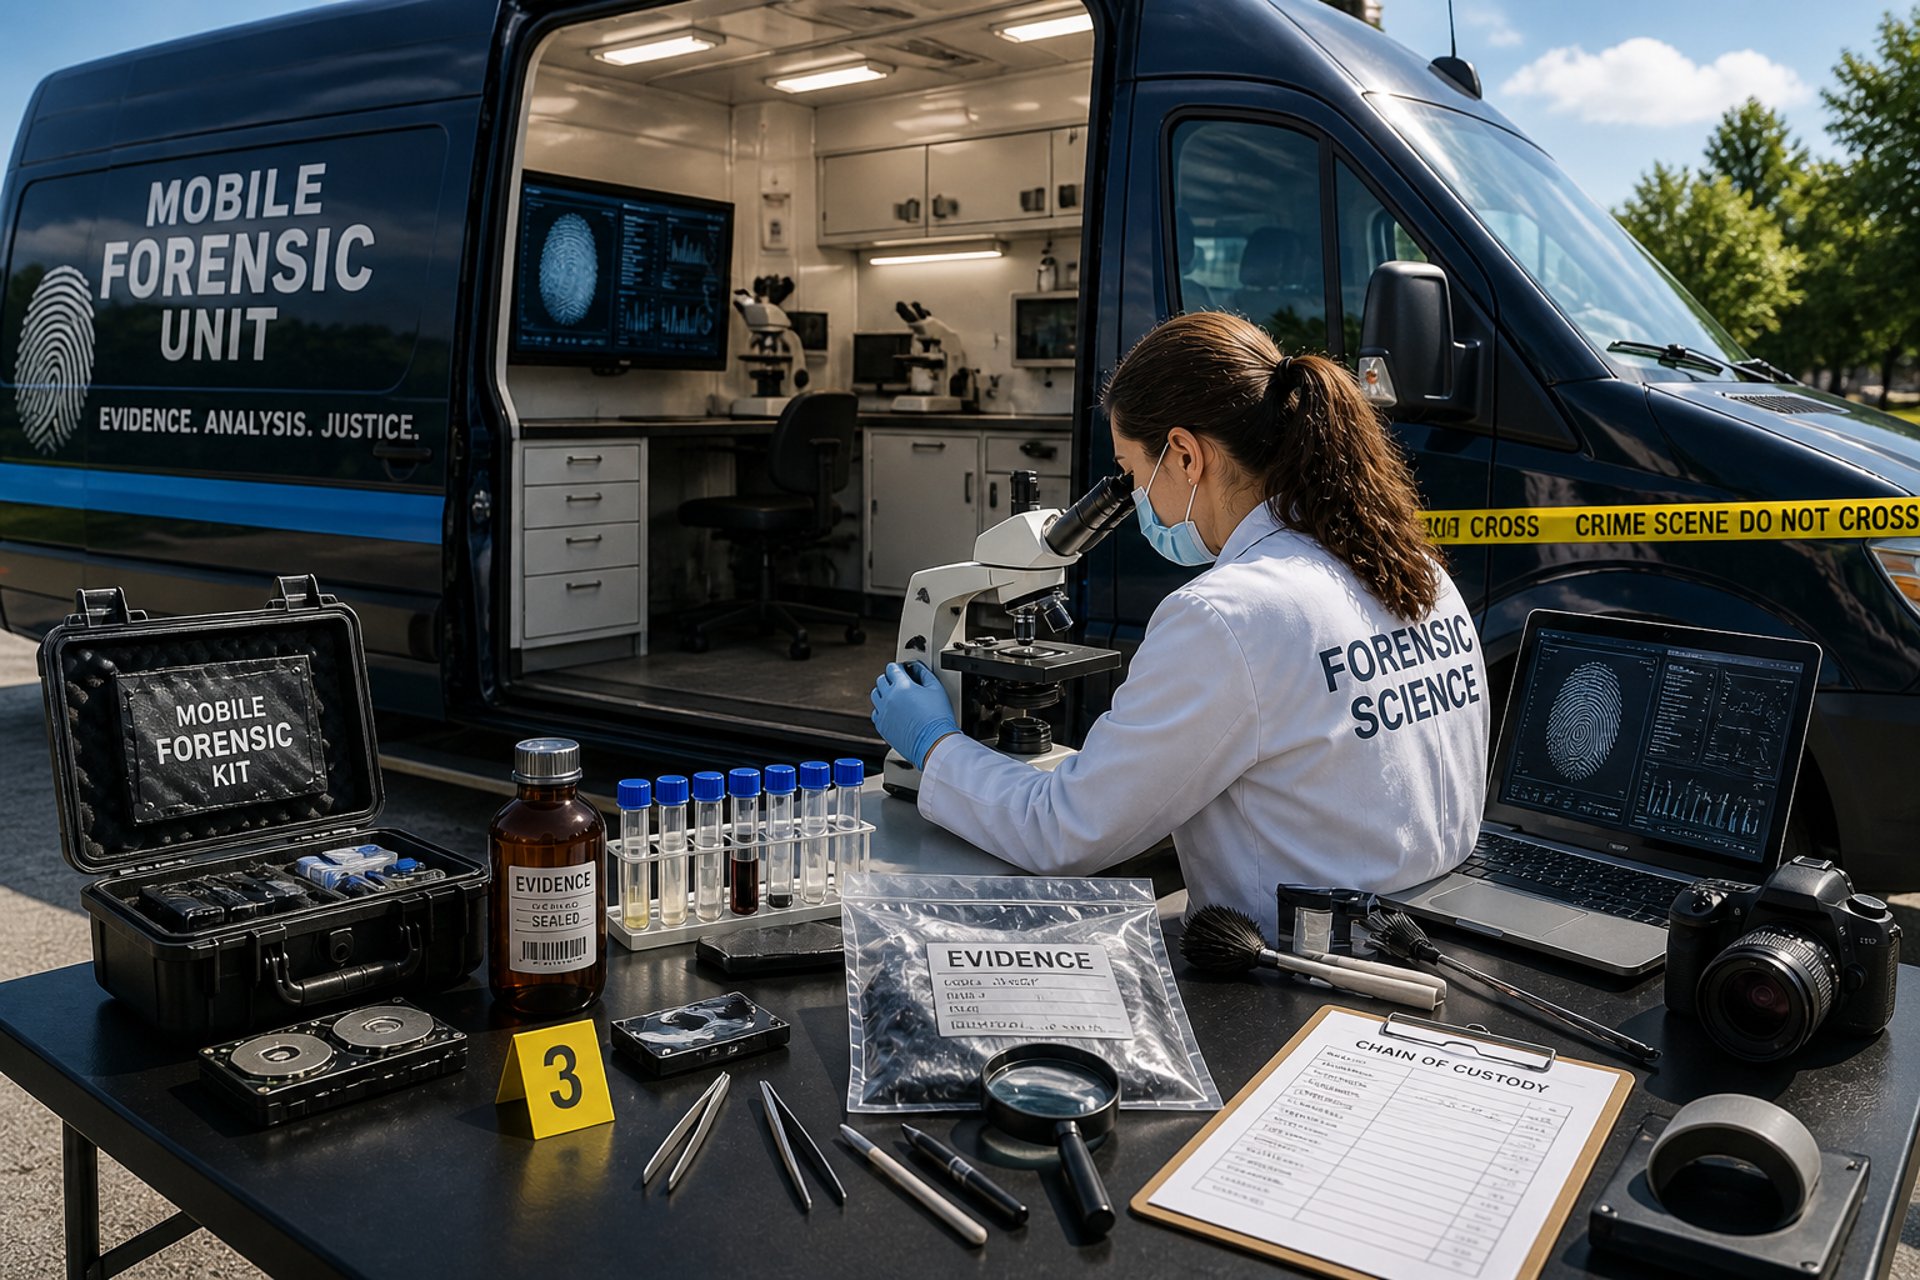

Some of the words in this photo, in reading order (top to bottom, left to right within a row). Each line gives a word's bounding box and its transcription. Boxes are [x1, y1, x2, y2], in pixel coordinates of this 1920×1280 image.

[146, 163, 326, 227] MOBILE
[100, 224, 375, 299] FORENSIC
[161, 307, 278, 361] UNIT
[100, 407, 198, 433] EVIDENCE.
[204, 410, 313, 437] ANALYSIS.
[321, 413, 419, 440] JUSTICE.
[1470, 515, 1539, 538] CROSS
[1576, 512, 1646, 536] CRIME
[1654, 510, 1729, 534] SCENE
[1740, 509, 1772, 533] DO
[1782, 507, 1830, 531] NOT
[1839, 504, 1919, 531] CROSS
[1319, 614, 1473, 692] FORENSIC
[175, 696, 266, 727] MOBILE
[1351, 664, 1480, 739] SCIENCE
[156, 722, 293, 764] FORENSIC
[212, 760, 251, 787] KIT
[516, 871, 591, 893] EVIDENCE
[531, 912, 580, 928] SEALED
[947, 950, 1093, 969] EVIDENCE
[543, 1044, 583, 1109] 3
[1356, 1040, 1416, 1062] CHAIN
[1421, 1056, 1449, 1068] OF
[1453, 1064, 1550, 1093] CUSTODY
